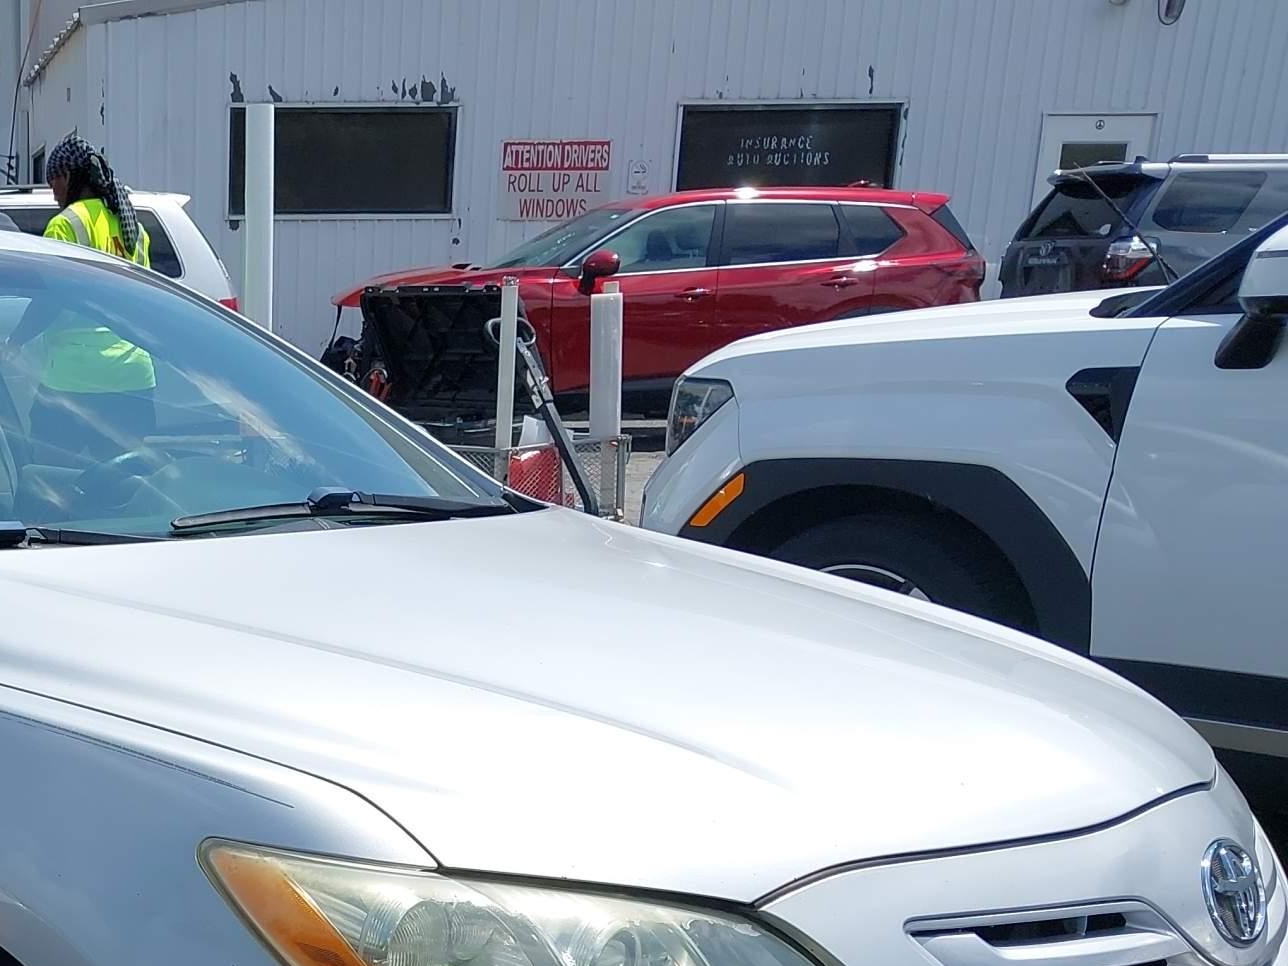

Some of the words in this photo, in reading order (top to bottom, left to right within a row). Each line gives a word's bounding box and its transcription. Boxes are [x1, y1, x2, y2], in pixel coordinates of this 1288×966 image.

[740, 135, 814, 150] INSURANCE
[503, 144, 562, 169] ATTENTION
[563, 144, 610, 169] DRIVERS
[507, 172, 544, 193] ROLL
[552, 172, 571, 193] UP
[574, 172, 601, 193] ALL
[519, 198, 587, 218] WINDOWS
